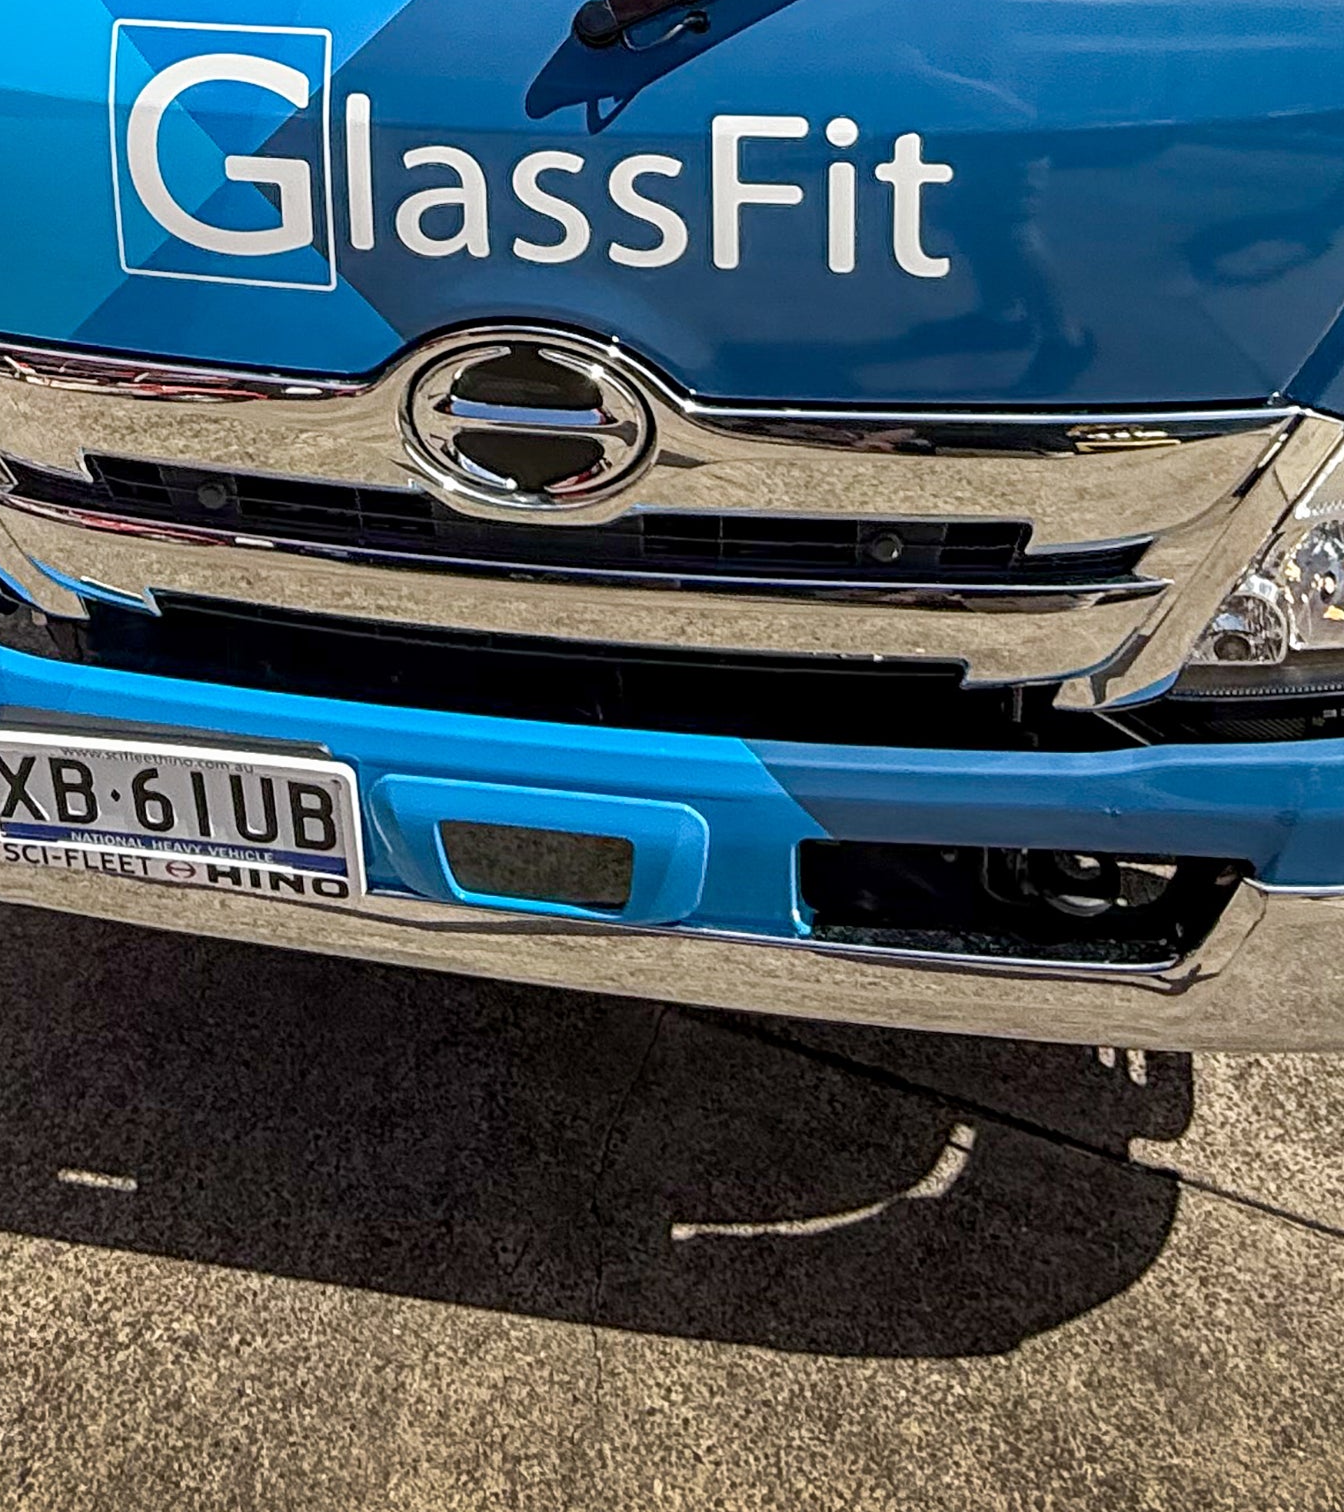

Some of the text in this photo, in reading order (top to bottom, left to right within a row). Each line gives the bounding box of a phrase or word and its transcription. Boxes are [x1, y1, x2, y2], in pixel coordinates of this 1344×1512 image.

[127, 52, 954, 280] GlassFit
[4, 843, 350, 899] SCI-FLEET HINO
[71, 831, 274, 863] NATIONAL HEAVY VEHICLE
